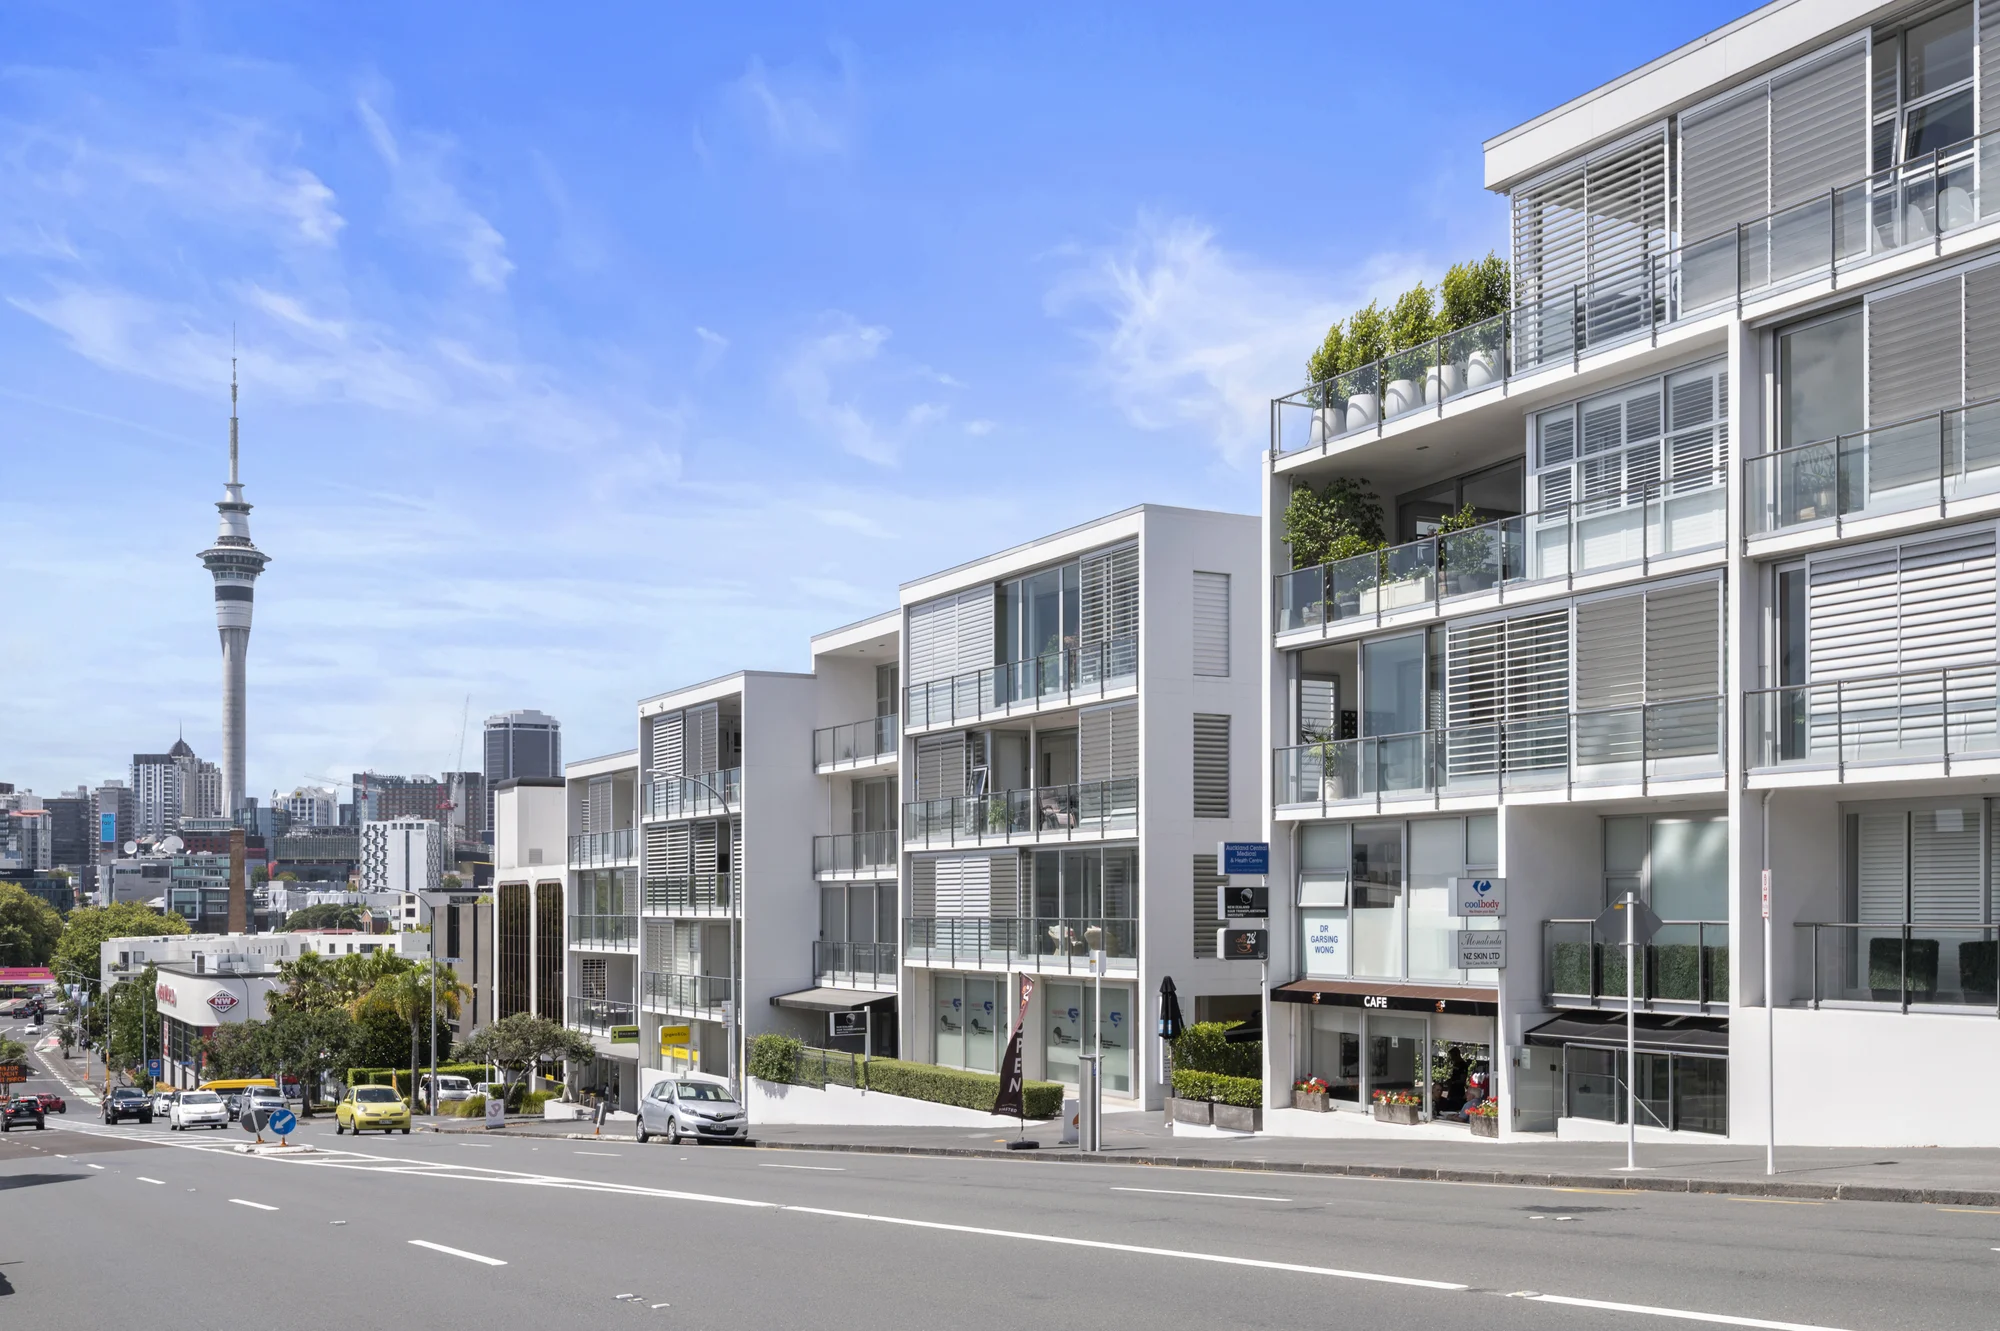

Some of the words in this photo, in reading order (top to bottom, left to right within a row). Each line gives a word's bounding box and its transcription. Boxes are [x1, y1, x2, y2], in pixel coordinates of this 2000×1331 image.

[1464, 900, 1500, 910] coolbody
[1315, 946, 1334, 954] WONG
[1464, 952, 1472, 960] NZ
[1473, 952, 1487, 960] SKIN
[1489, 952, 1500, 960] LTD
[1364, 996, 1387, 1008] CAFE
